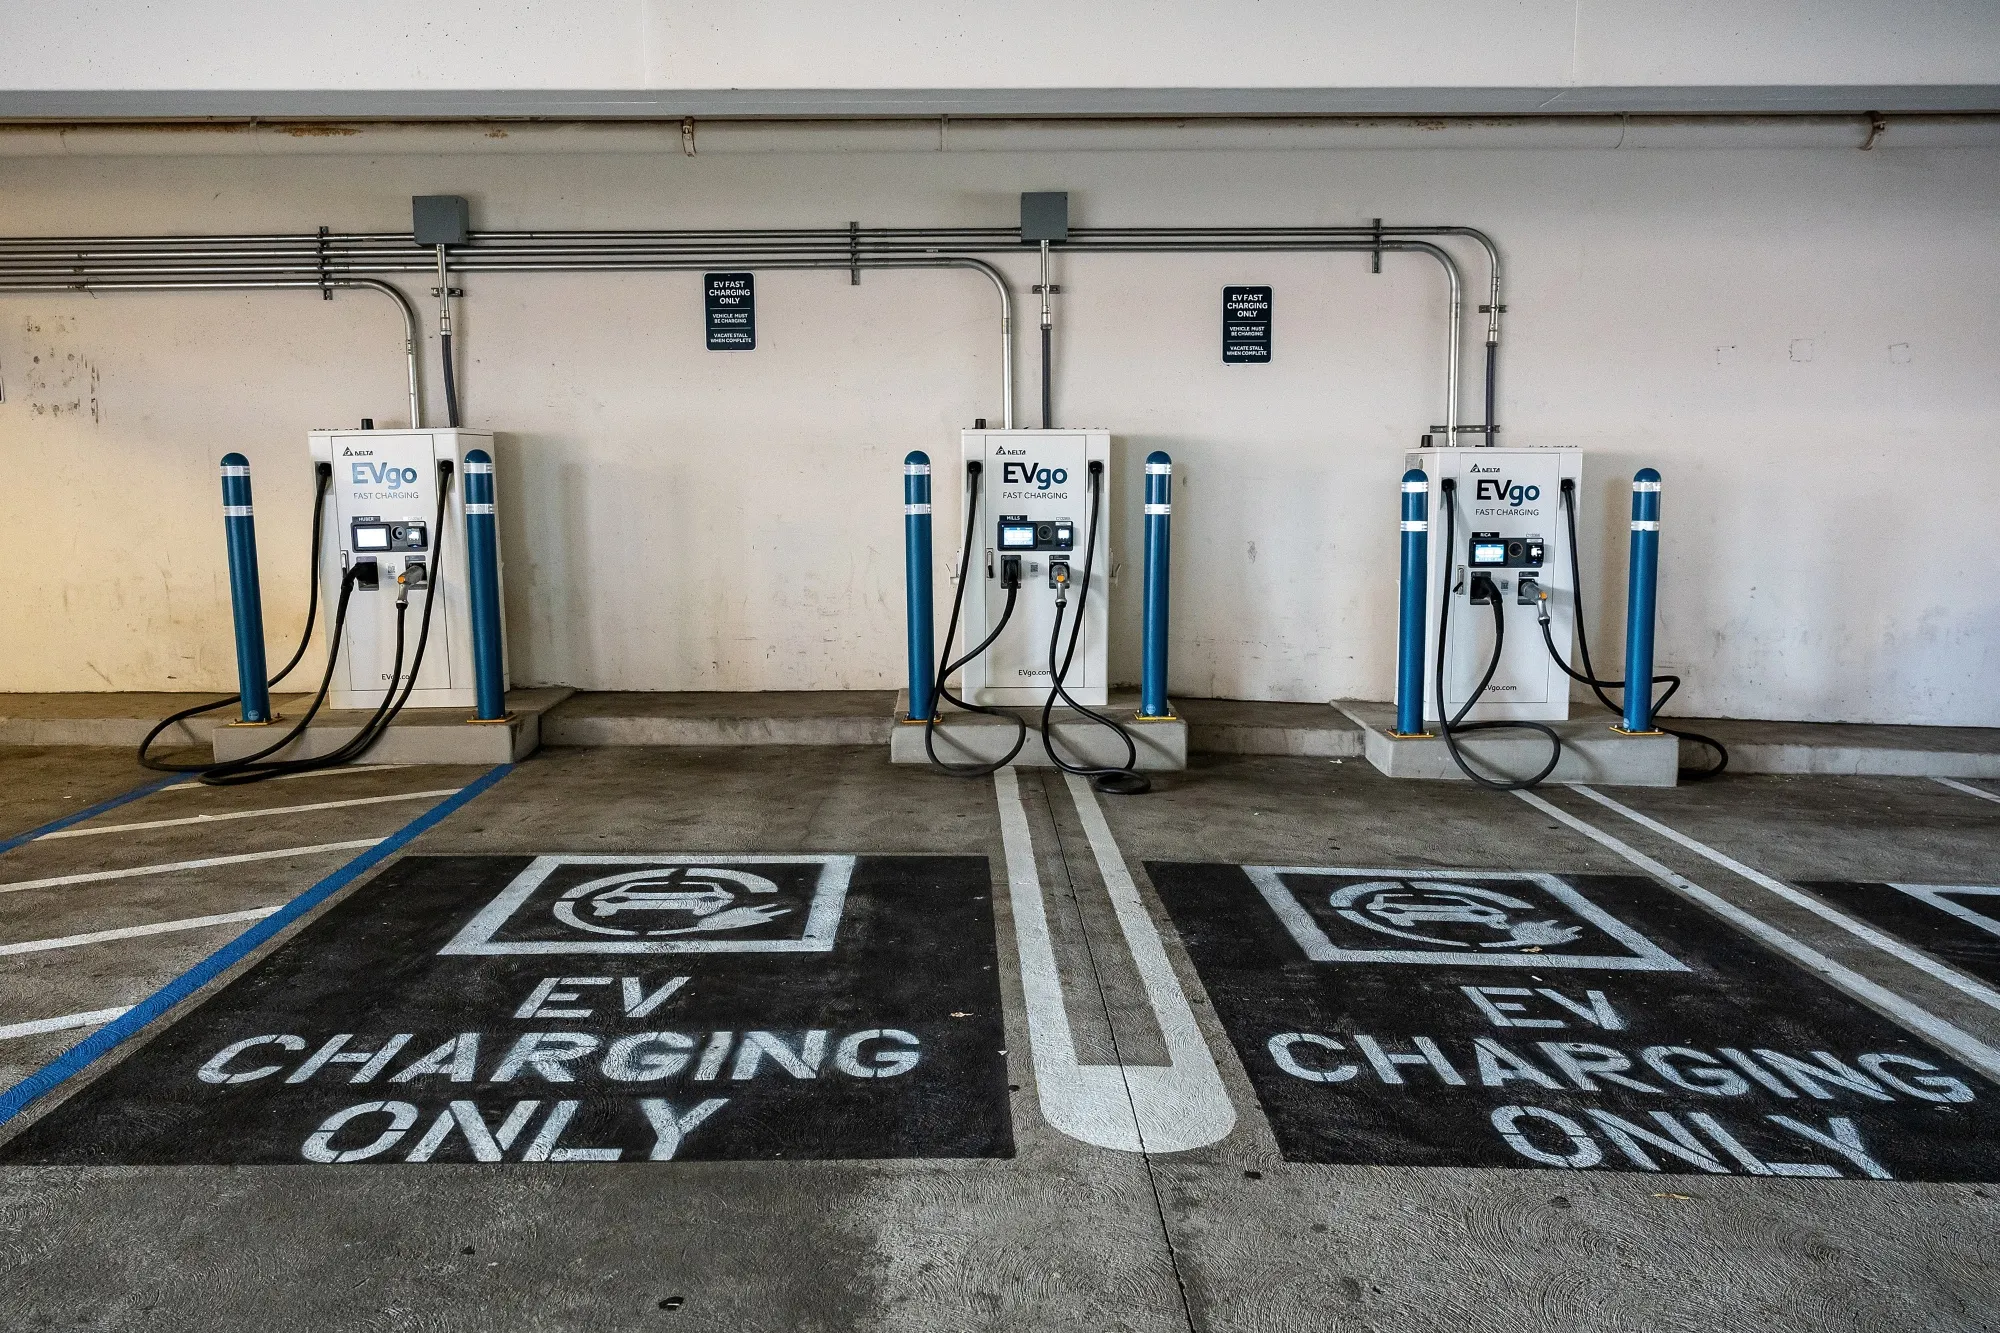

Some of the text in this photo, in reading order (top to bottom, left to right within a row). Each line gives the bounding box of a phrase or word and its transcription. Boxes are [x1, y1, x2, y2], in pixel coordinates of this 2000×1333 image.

[352, 462, 417, 490] EVgo
[1004, 462, 1068, 490] EVgo
[1477, 479, 1540, 507] EVgo
[513, 977, 692, 1018] EV
[1460, 986, 1627, 1030] EV
[196, 1028, 922, 1084] CHARGING
[1265, 1032, 1975, 1102] CHARGING
[301, 1097, 730, 1164] ONLY
[1490, 1105, 1895, 1180] ONLY
